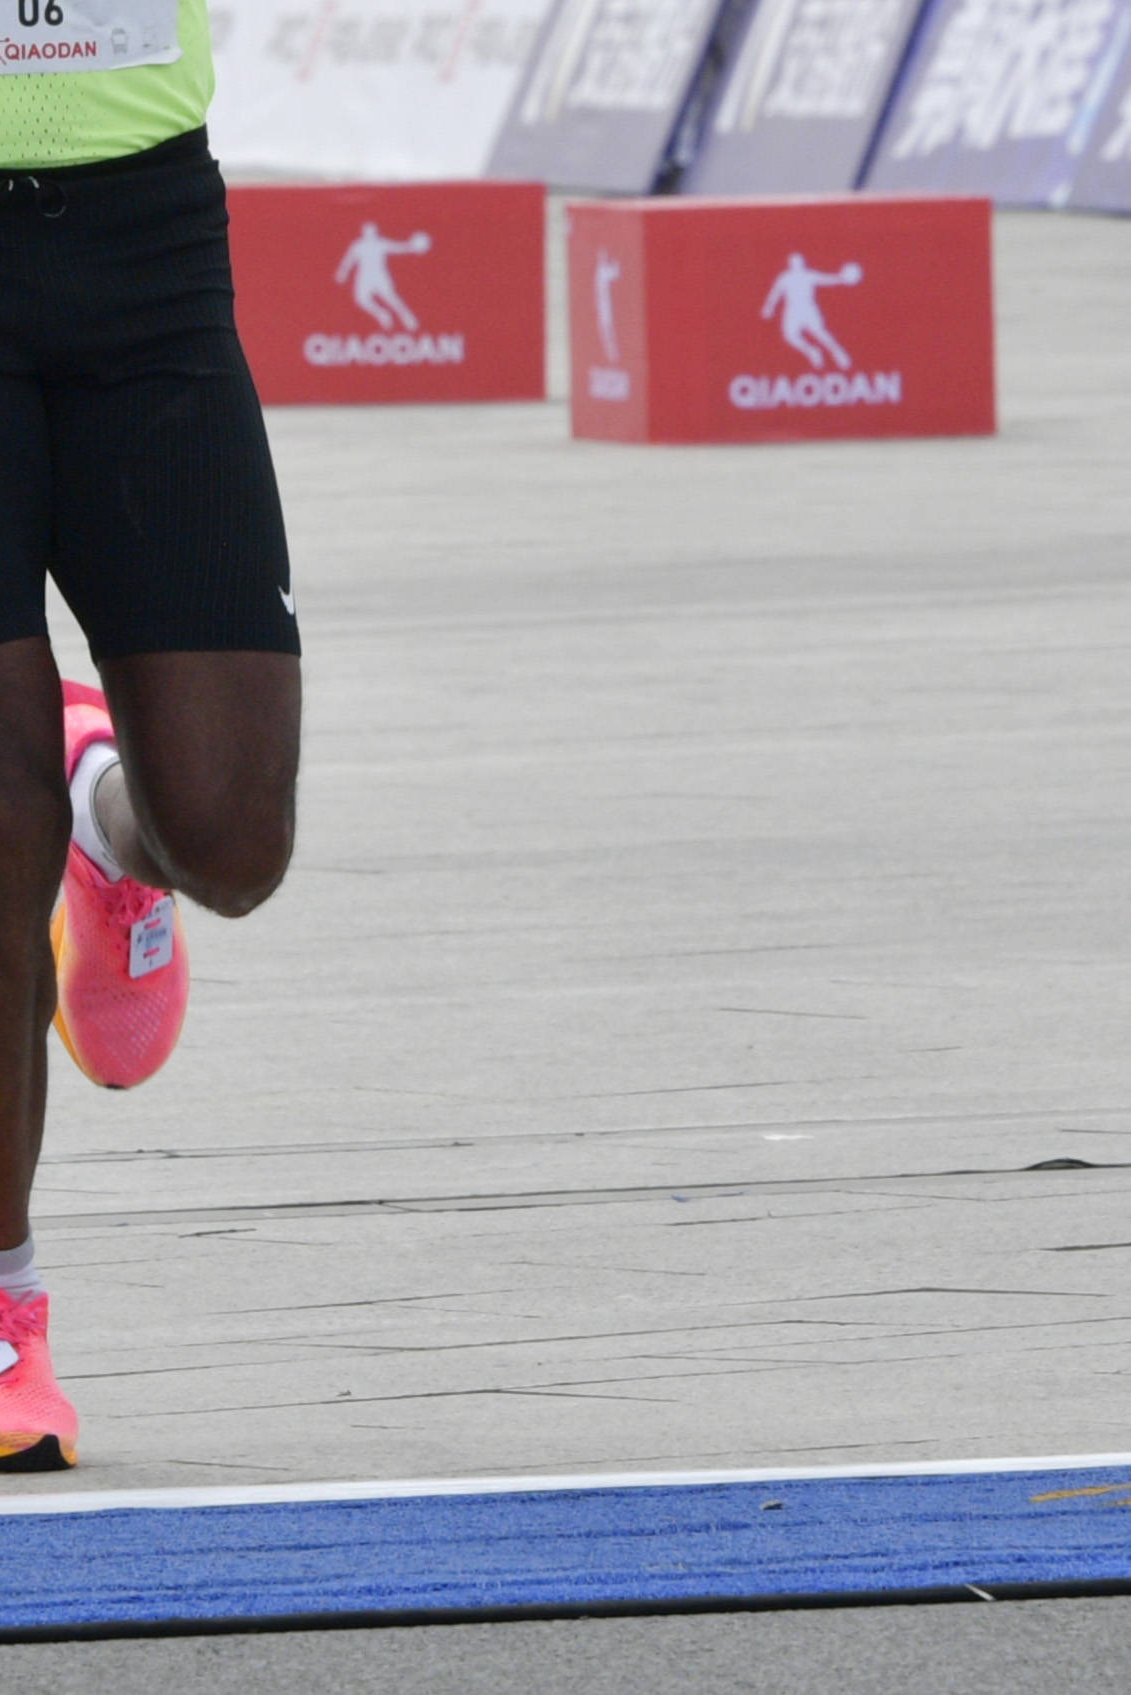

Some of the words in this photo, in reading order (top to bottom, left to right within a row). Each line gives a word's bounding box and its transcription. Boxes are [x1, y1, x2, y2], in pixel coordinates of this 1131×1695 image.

[5, 41, 97, 61] QIAODAN
[304, 333, 464, 366] QIAODAN
[729, 371, 901, 410] QIAODAN
